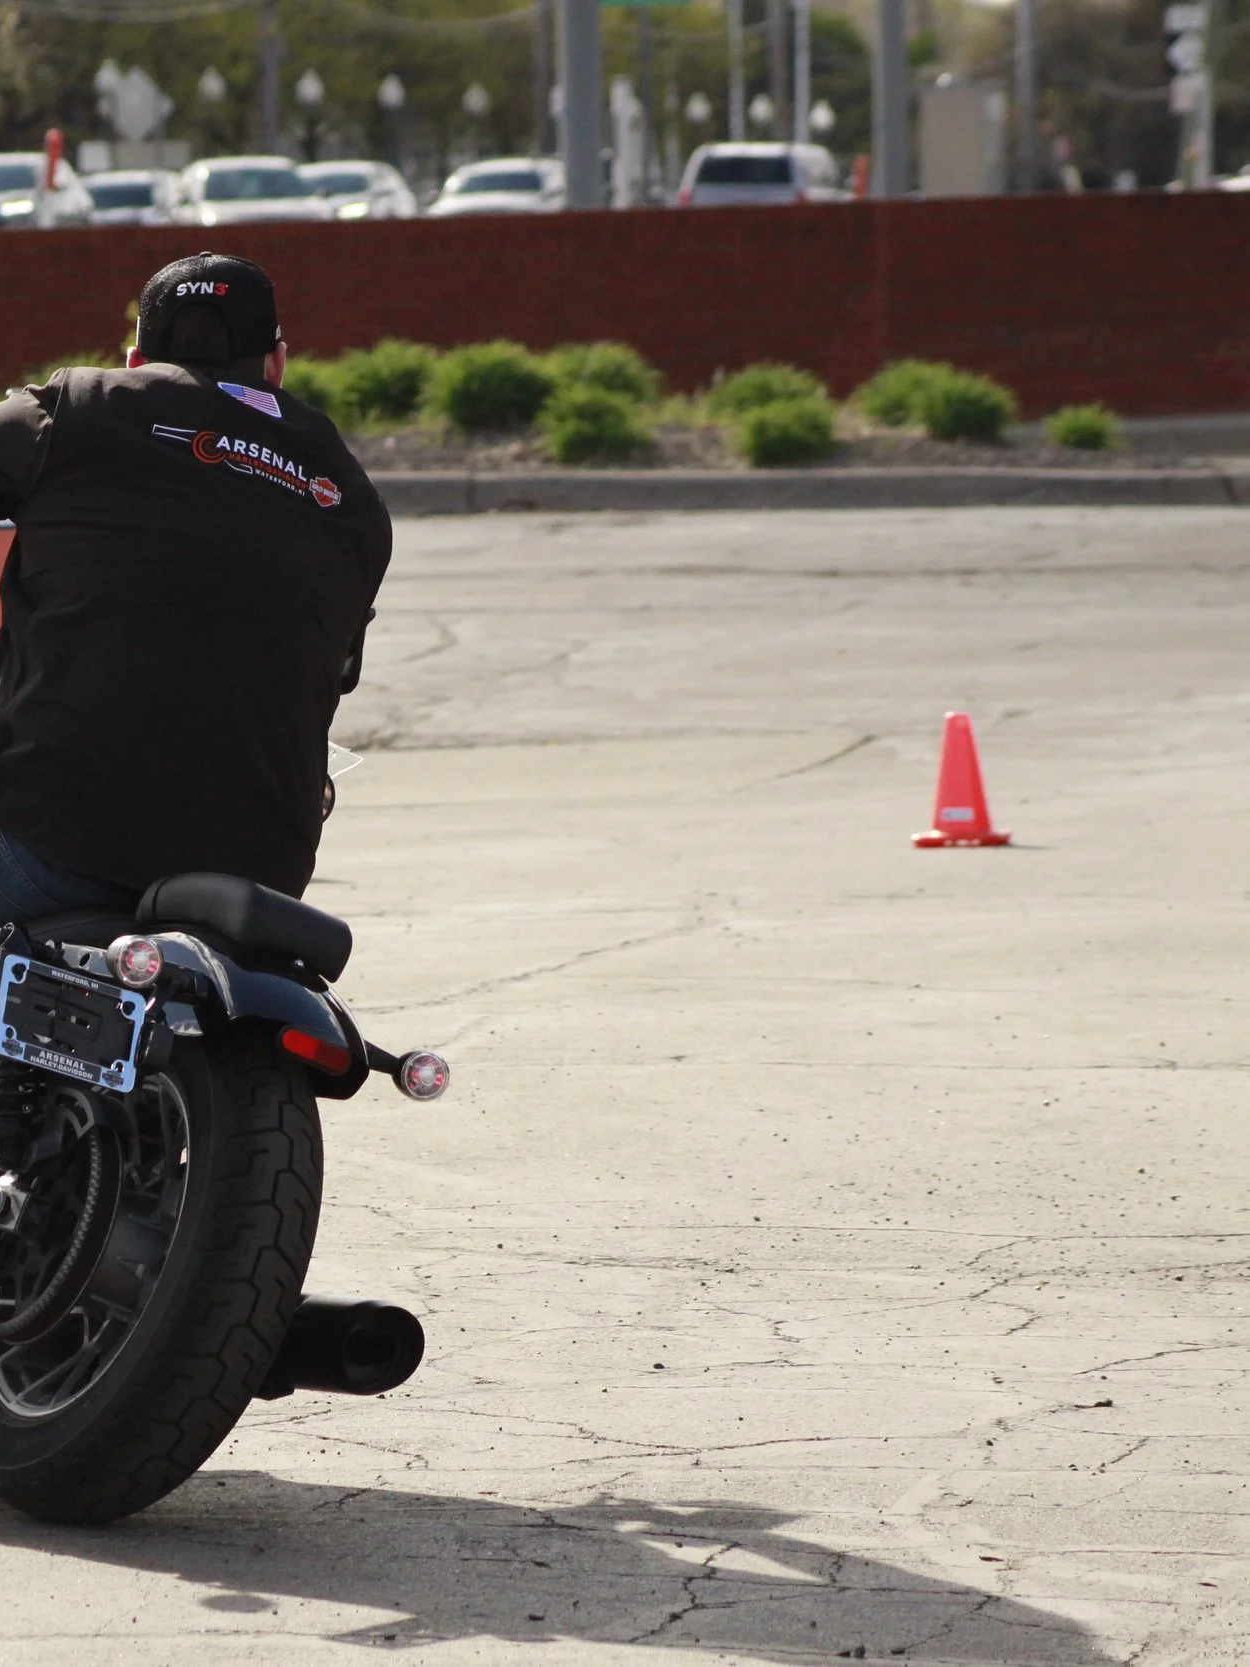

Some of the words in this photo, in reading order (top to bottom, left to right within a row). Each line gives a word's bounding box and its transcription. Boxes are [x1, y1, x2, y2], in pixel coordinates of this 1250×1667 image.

[176, 281, 227, 297] SYN3
[216, 435, 307, 482] ARSENAL
[30, 1055, 94, 1080] HARLEY-DAVIDSON
[39, 1050, 86, 1071] ARSENAL
